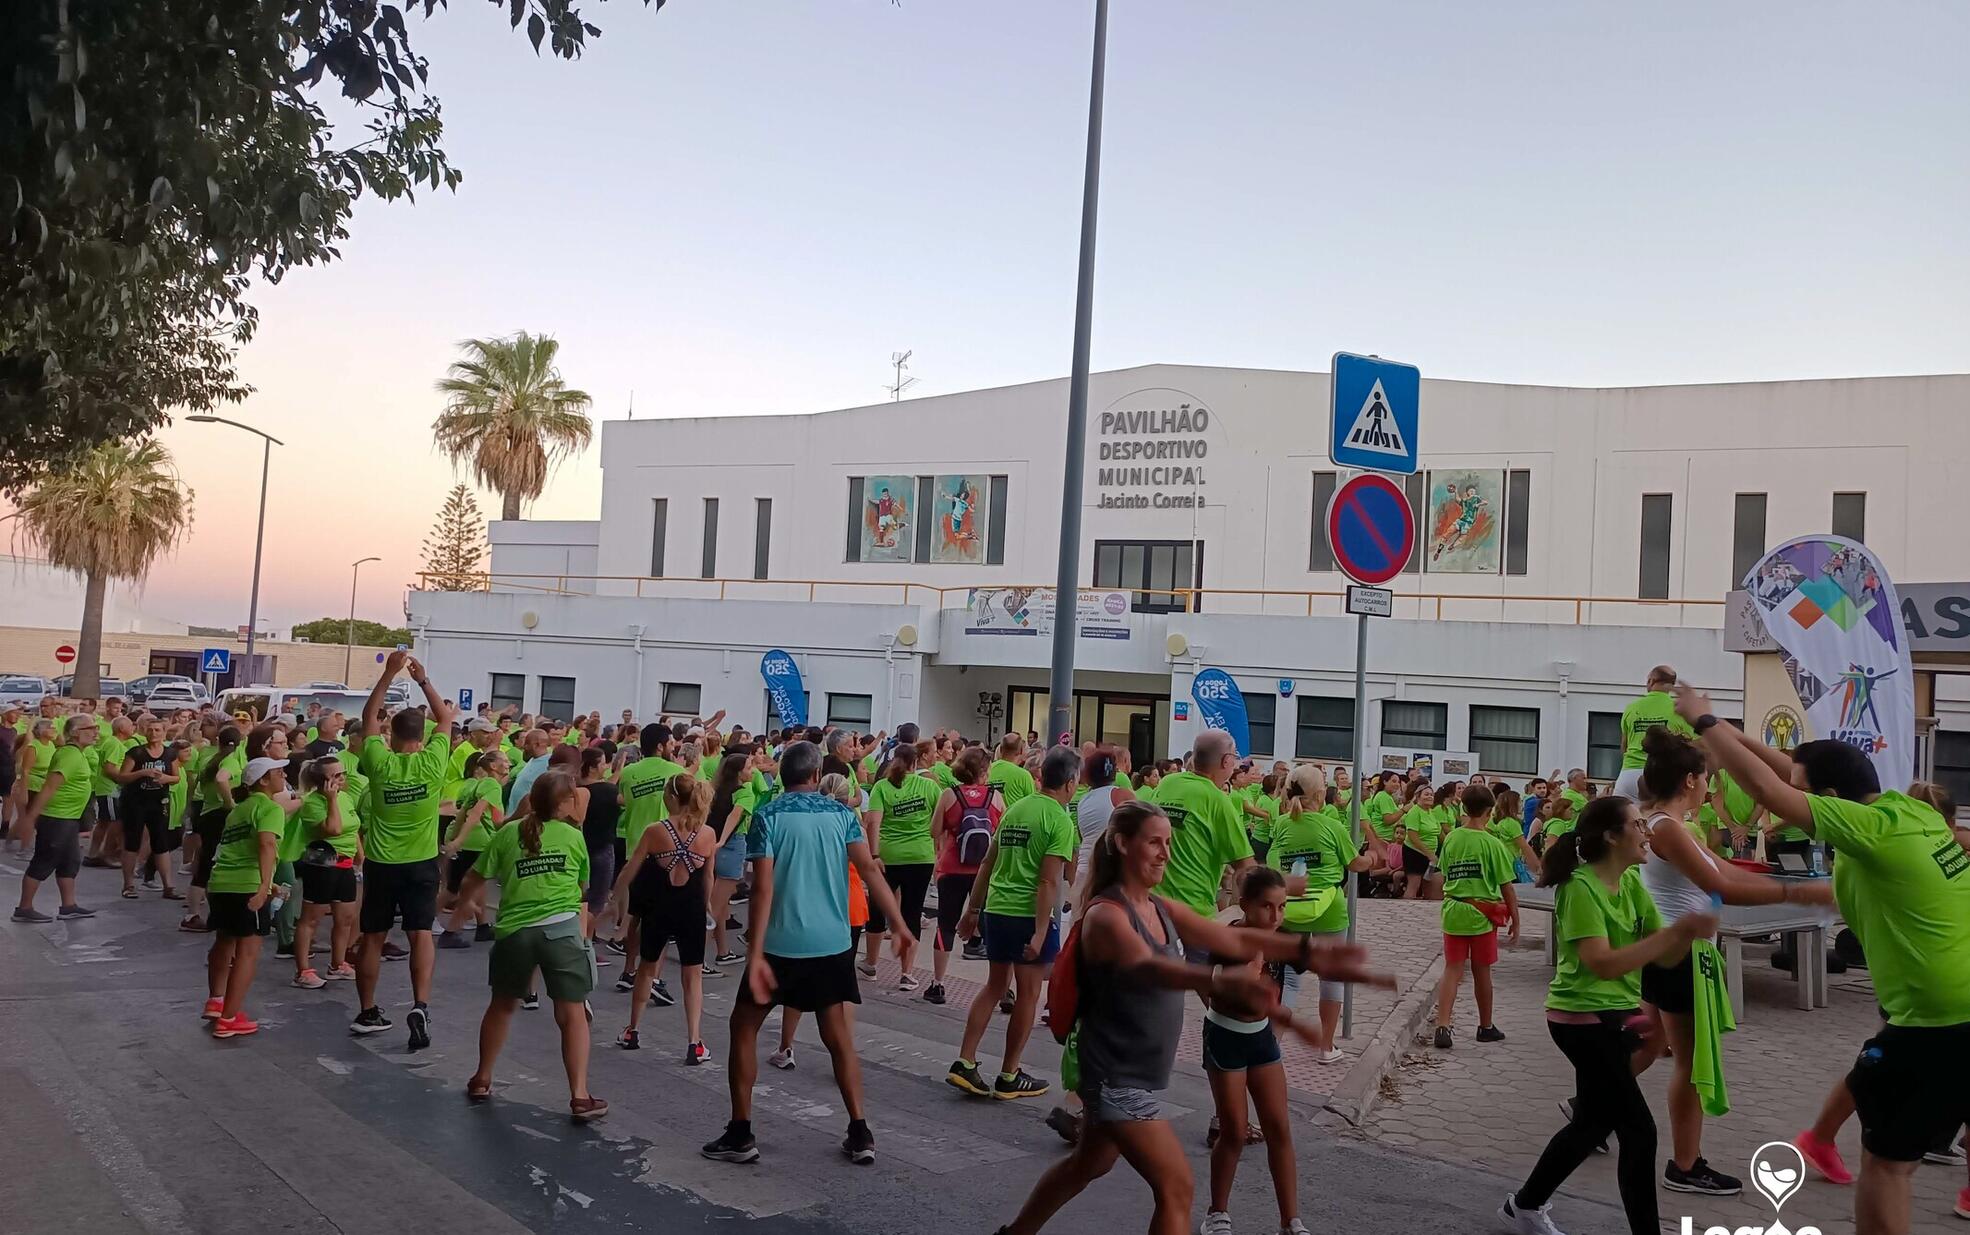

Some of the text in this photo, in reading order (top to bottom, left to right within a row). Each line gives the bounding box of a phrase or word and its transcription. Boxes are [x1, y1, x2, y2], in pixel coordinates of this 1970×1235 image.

[1101, 404, 1209, 435] PAVILHÃO
[1100, 440, 1207, 460] DESPORTIVO
[1099, 467, 1206, 486] MUNICIPAL
[1097, 492, 1205, 509] Jacinto Correia
[1360, 590, 1383, 598] EXCEPTO
[1355, 597, 1387, 606] AUTOCARROS
[1743, 630, 1769, 648] CAFETARI
[462, 690, 470, 702] P
[385, 787, 426, 798] CAMINHADAS
[519, 857, 564, 868] CAMINHADAS
[530, 865, 549, 874] LUAR
